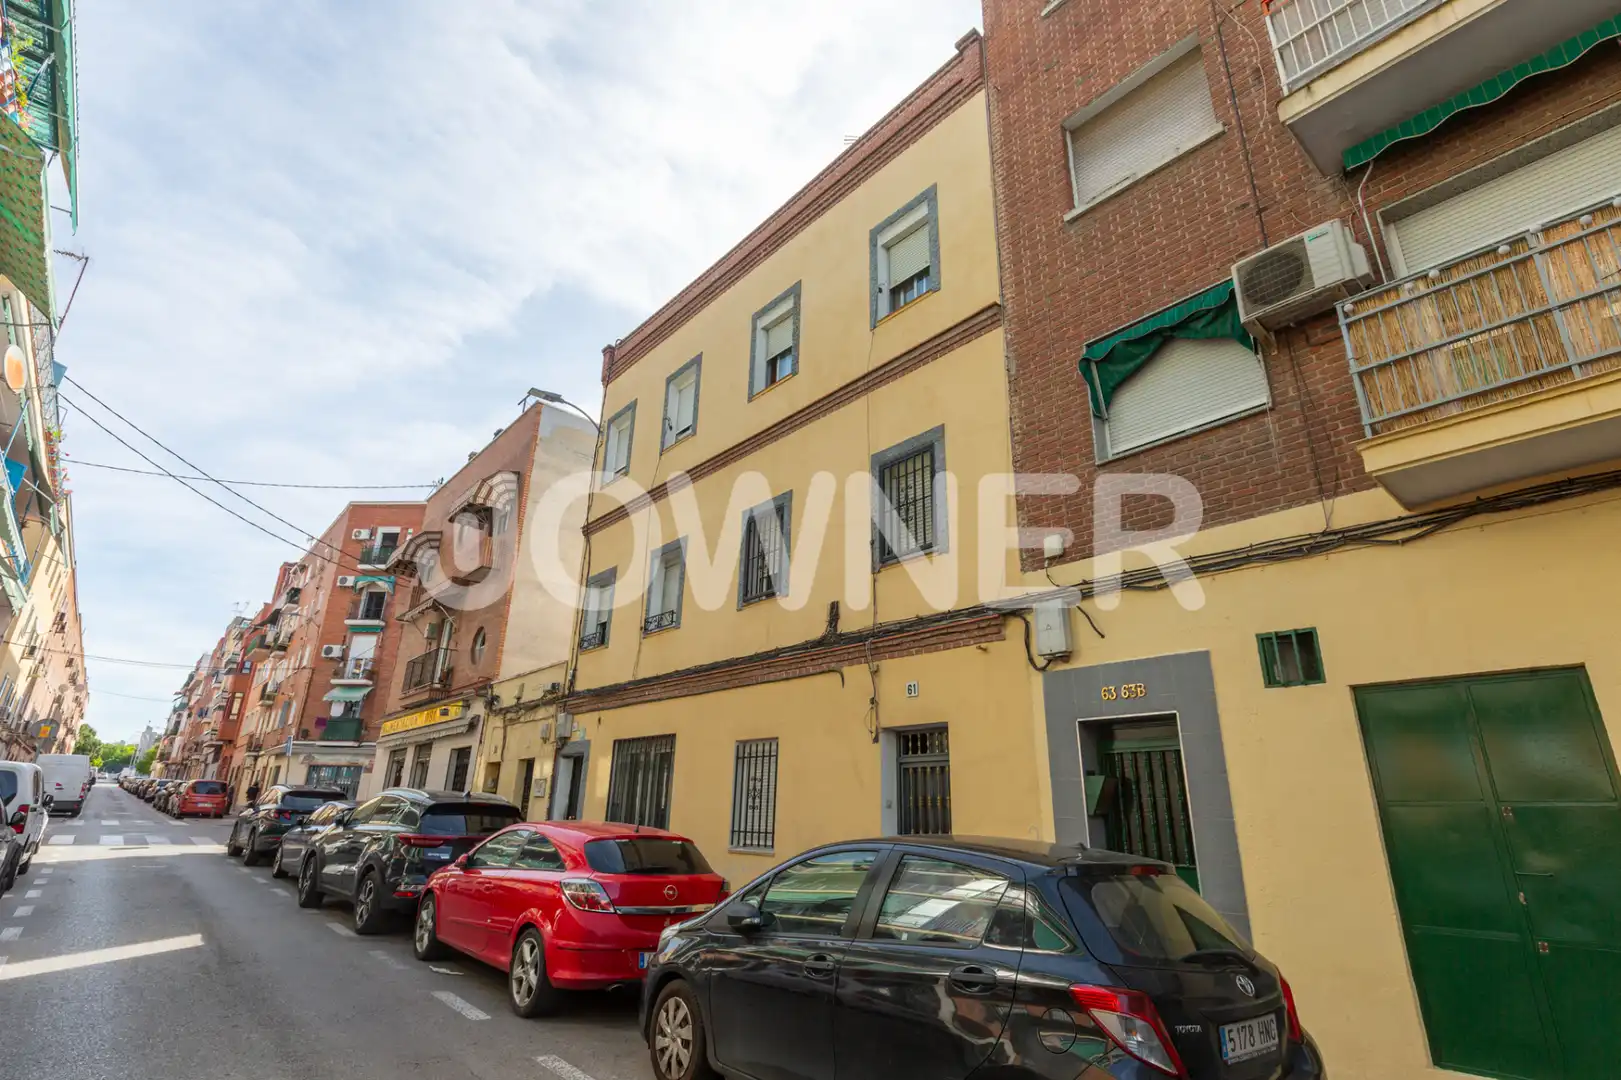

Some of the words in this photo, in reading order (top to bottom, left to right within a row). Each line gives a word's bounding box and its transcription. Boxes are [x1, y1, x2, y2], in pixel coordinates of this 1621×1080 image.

[907, 684, 917, 695] 61
[1101, 686, 1117, 700] 63
[1121, 683, 1146, 698] 63B
[1174, 1024, 1203, 1034] TOYOTA
[1228, 1024, 1256, 1053] 5178
